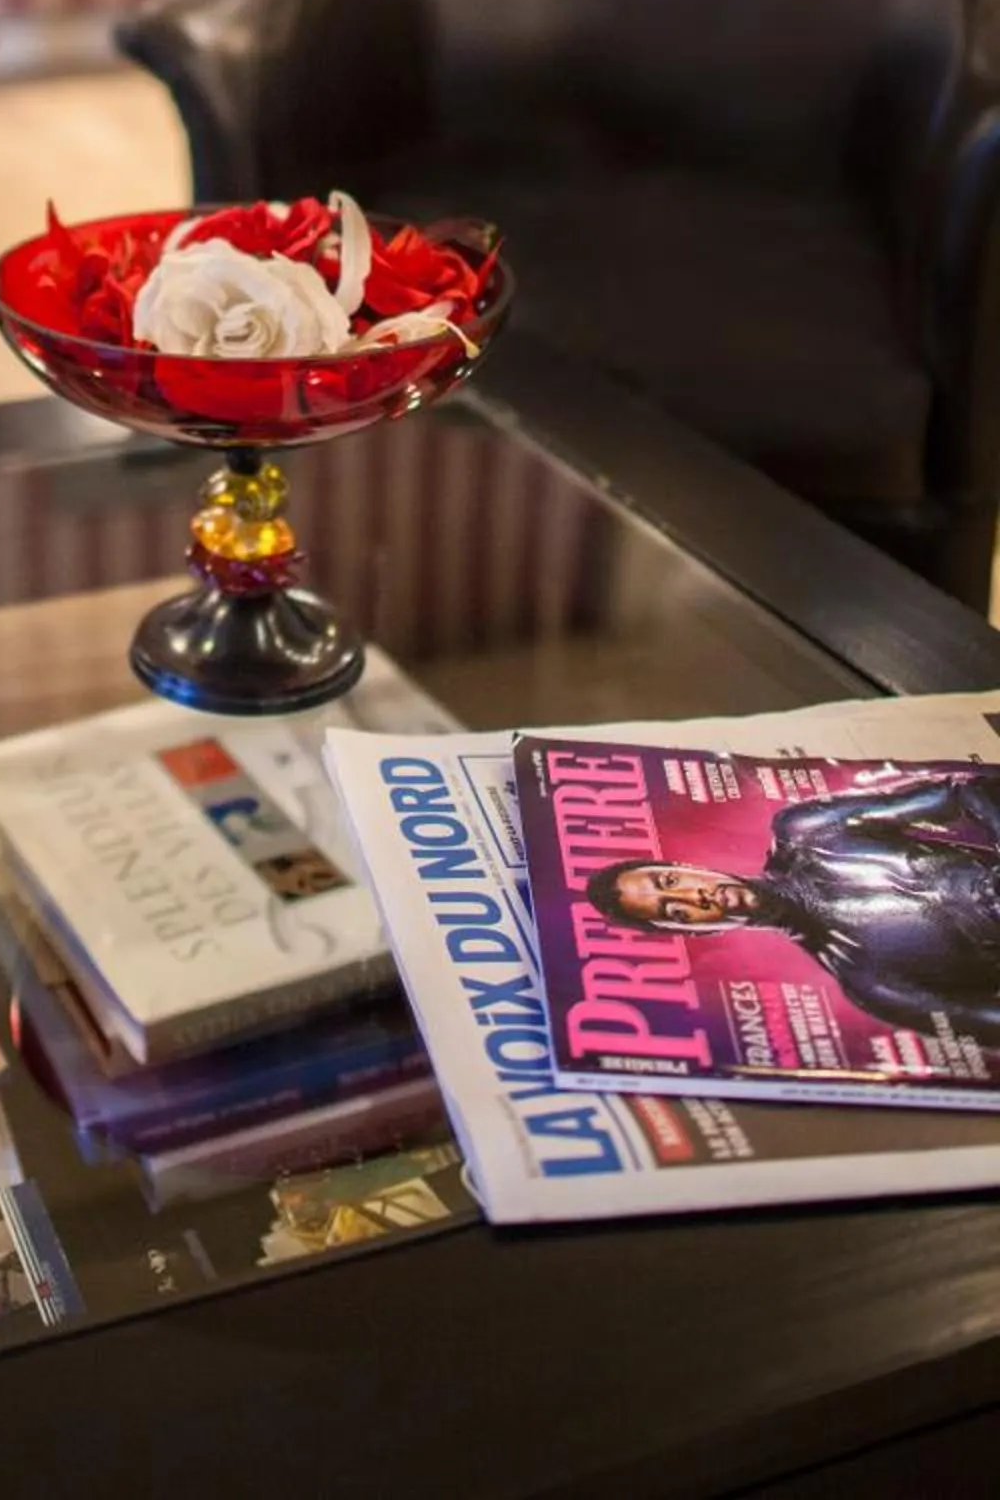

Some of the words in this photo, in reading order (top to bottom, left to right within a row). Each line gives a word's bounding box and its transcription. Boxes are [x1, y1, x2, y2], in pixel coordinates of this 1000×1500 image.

[379, 757, 484, 879] NORD
[427, 892, 522, 963] DU
[729, 981, 776, 1067] FRANCES
[522, 1106, 623, 1178] LA
